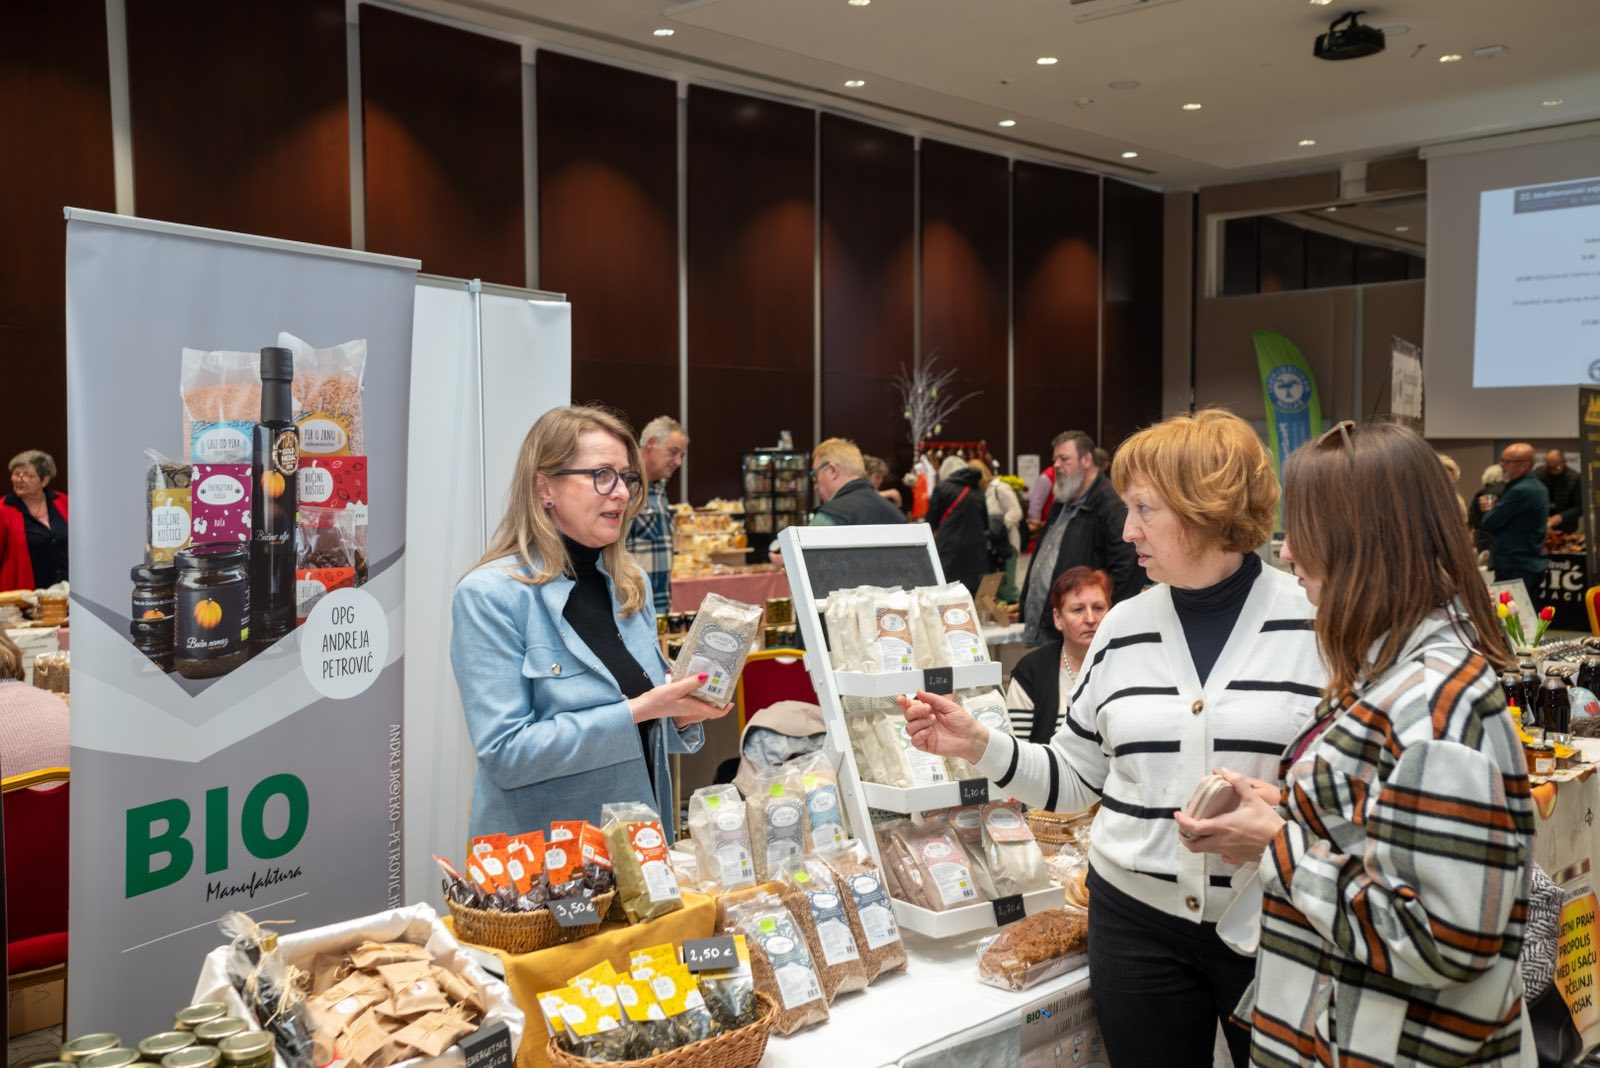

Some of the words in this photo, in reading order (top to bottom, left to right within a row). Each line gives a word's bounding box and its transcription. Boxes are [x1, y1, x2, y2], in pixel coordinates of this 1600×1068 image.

[304, 429, 313, 440] PIR
[320, 429, 335, 440] ZRNU
[157, 511, 180, 526] BUČINE
[157, 526, 181, 541] KOŠTICE
[331, 605, 355, 625] OPG
[322, 630, 370, 653] ANDREJA
[322, 651, 373, 679] PETROVIĆ
[125, 772, 309, 899] BIO
[205, 866, 302, 902] Manufaktura
[1575, 911, 1595, 929] PRAH
[690, 948, 720, 962] 2,50
[723, 948, 733, 956] €
[1558, 933, 1591, 959] PROPOLIS
[1556, 963, 1570, 979] MED
[1571, 960, 1577, 973] U
[1564, 972, 1593, 998] PČELINJI
[1569, 993, 1593, 1016] VOSAK
[1026, 1009, 1041, 1025] BIO
